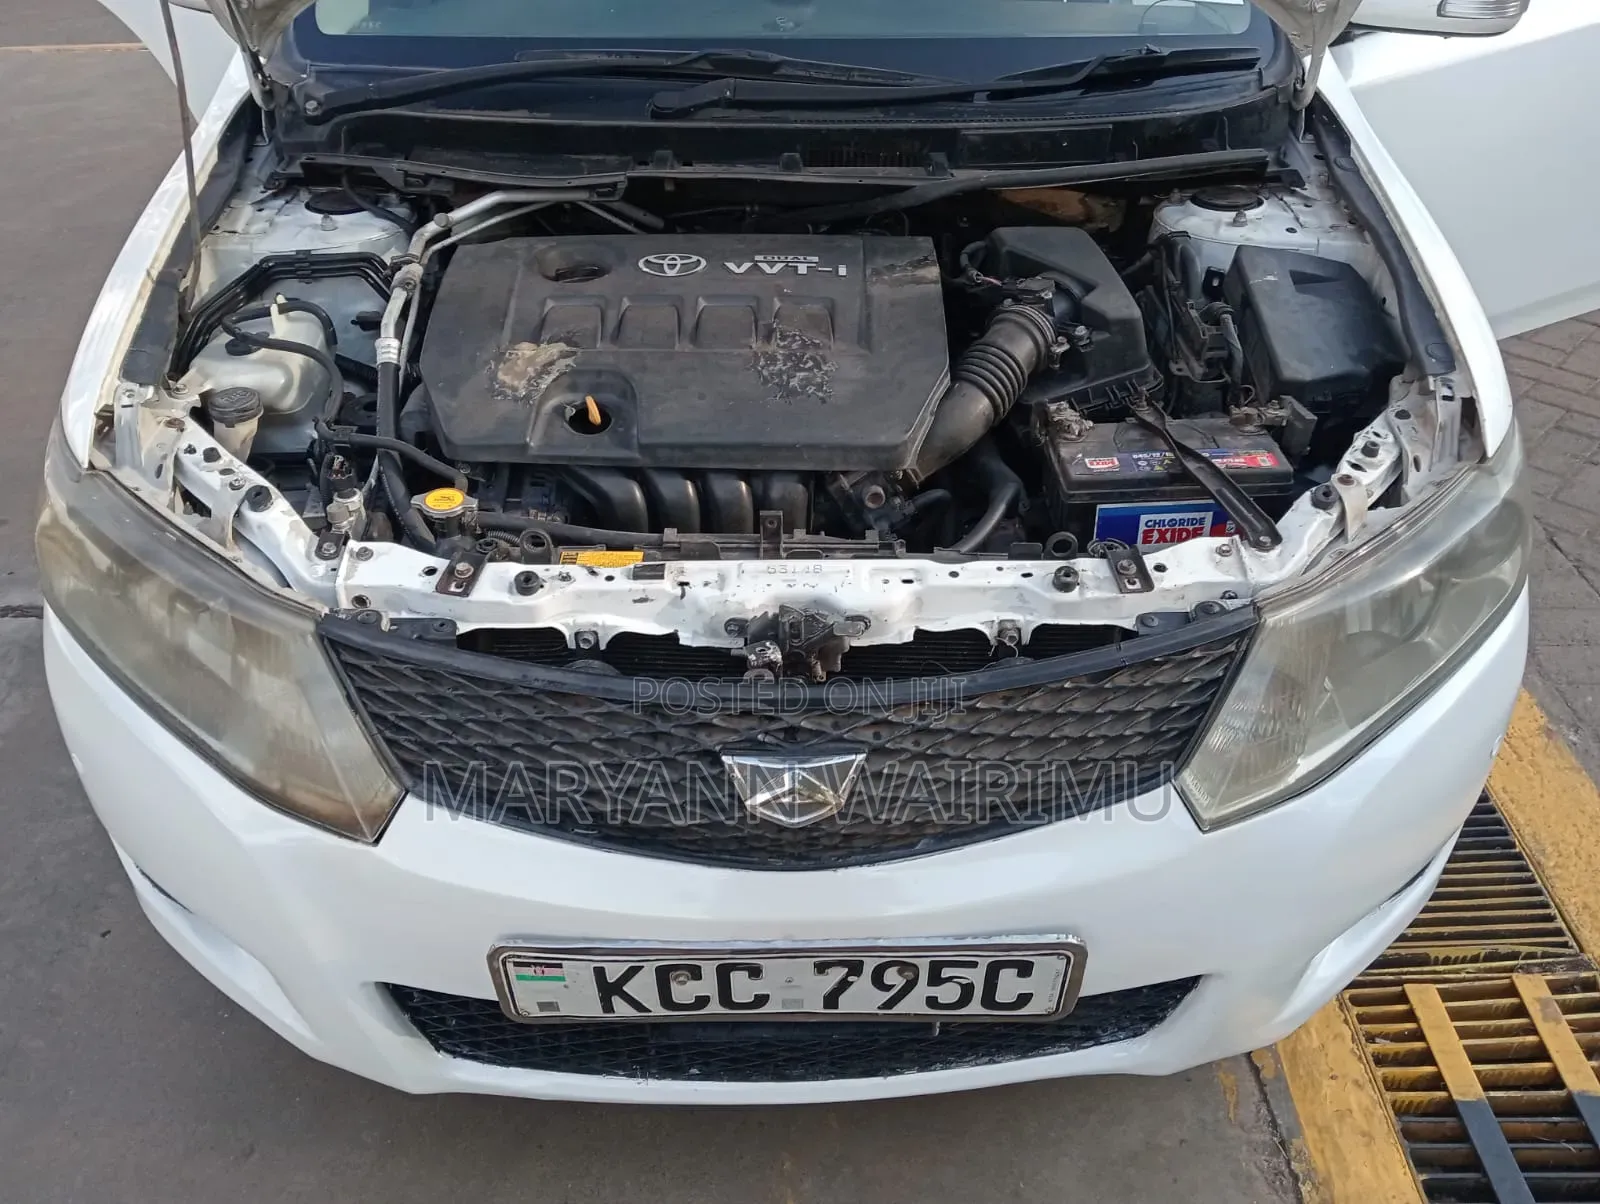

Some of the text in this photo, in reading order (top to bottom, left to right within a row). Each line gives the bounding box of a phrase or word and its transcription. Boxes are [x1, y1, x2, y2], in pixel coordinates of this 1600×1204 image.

[1144, 517, 1206, 528] CHLORIDE
[1141, 526, 1206, 545] EXIDE
[593, 962, 770, 1013] KCC
[813, 959, 1035, 1011] 795C
